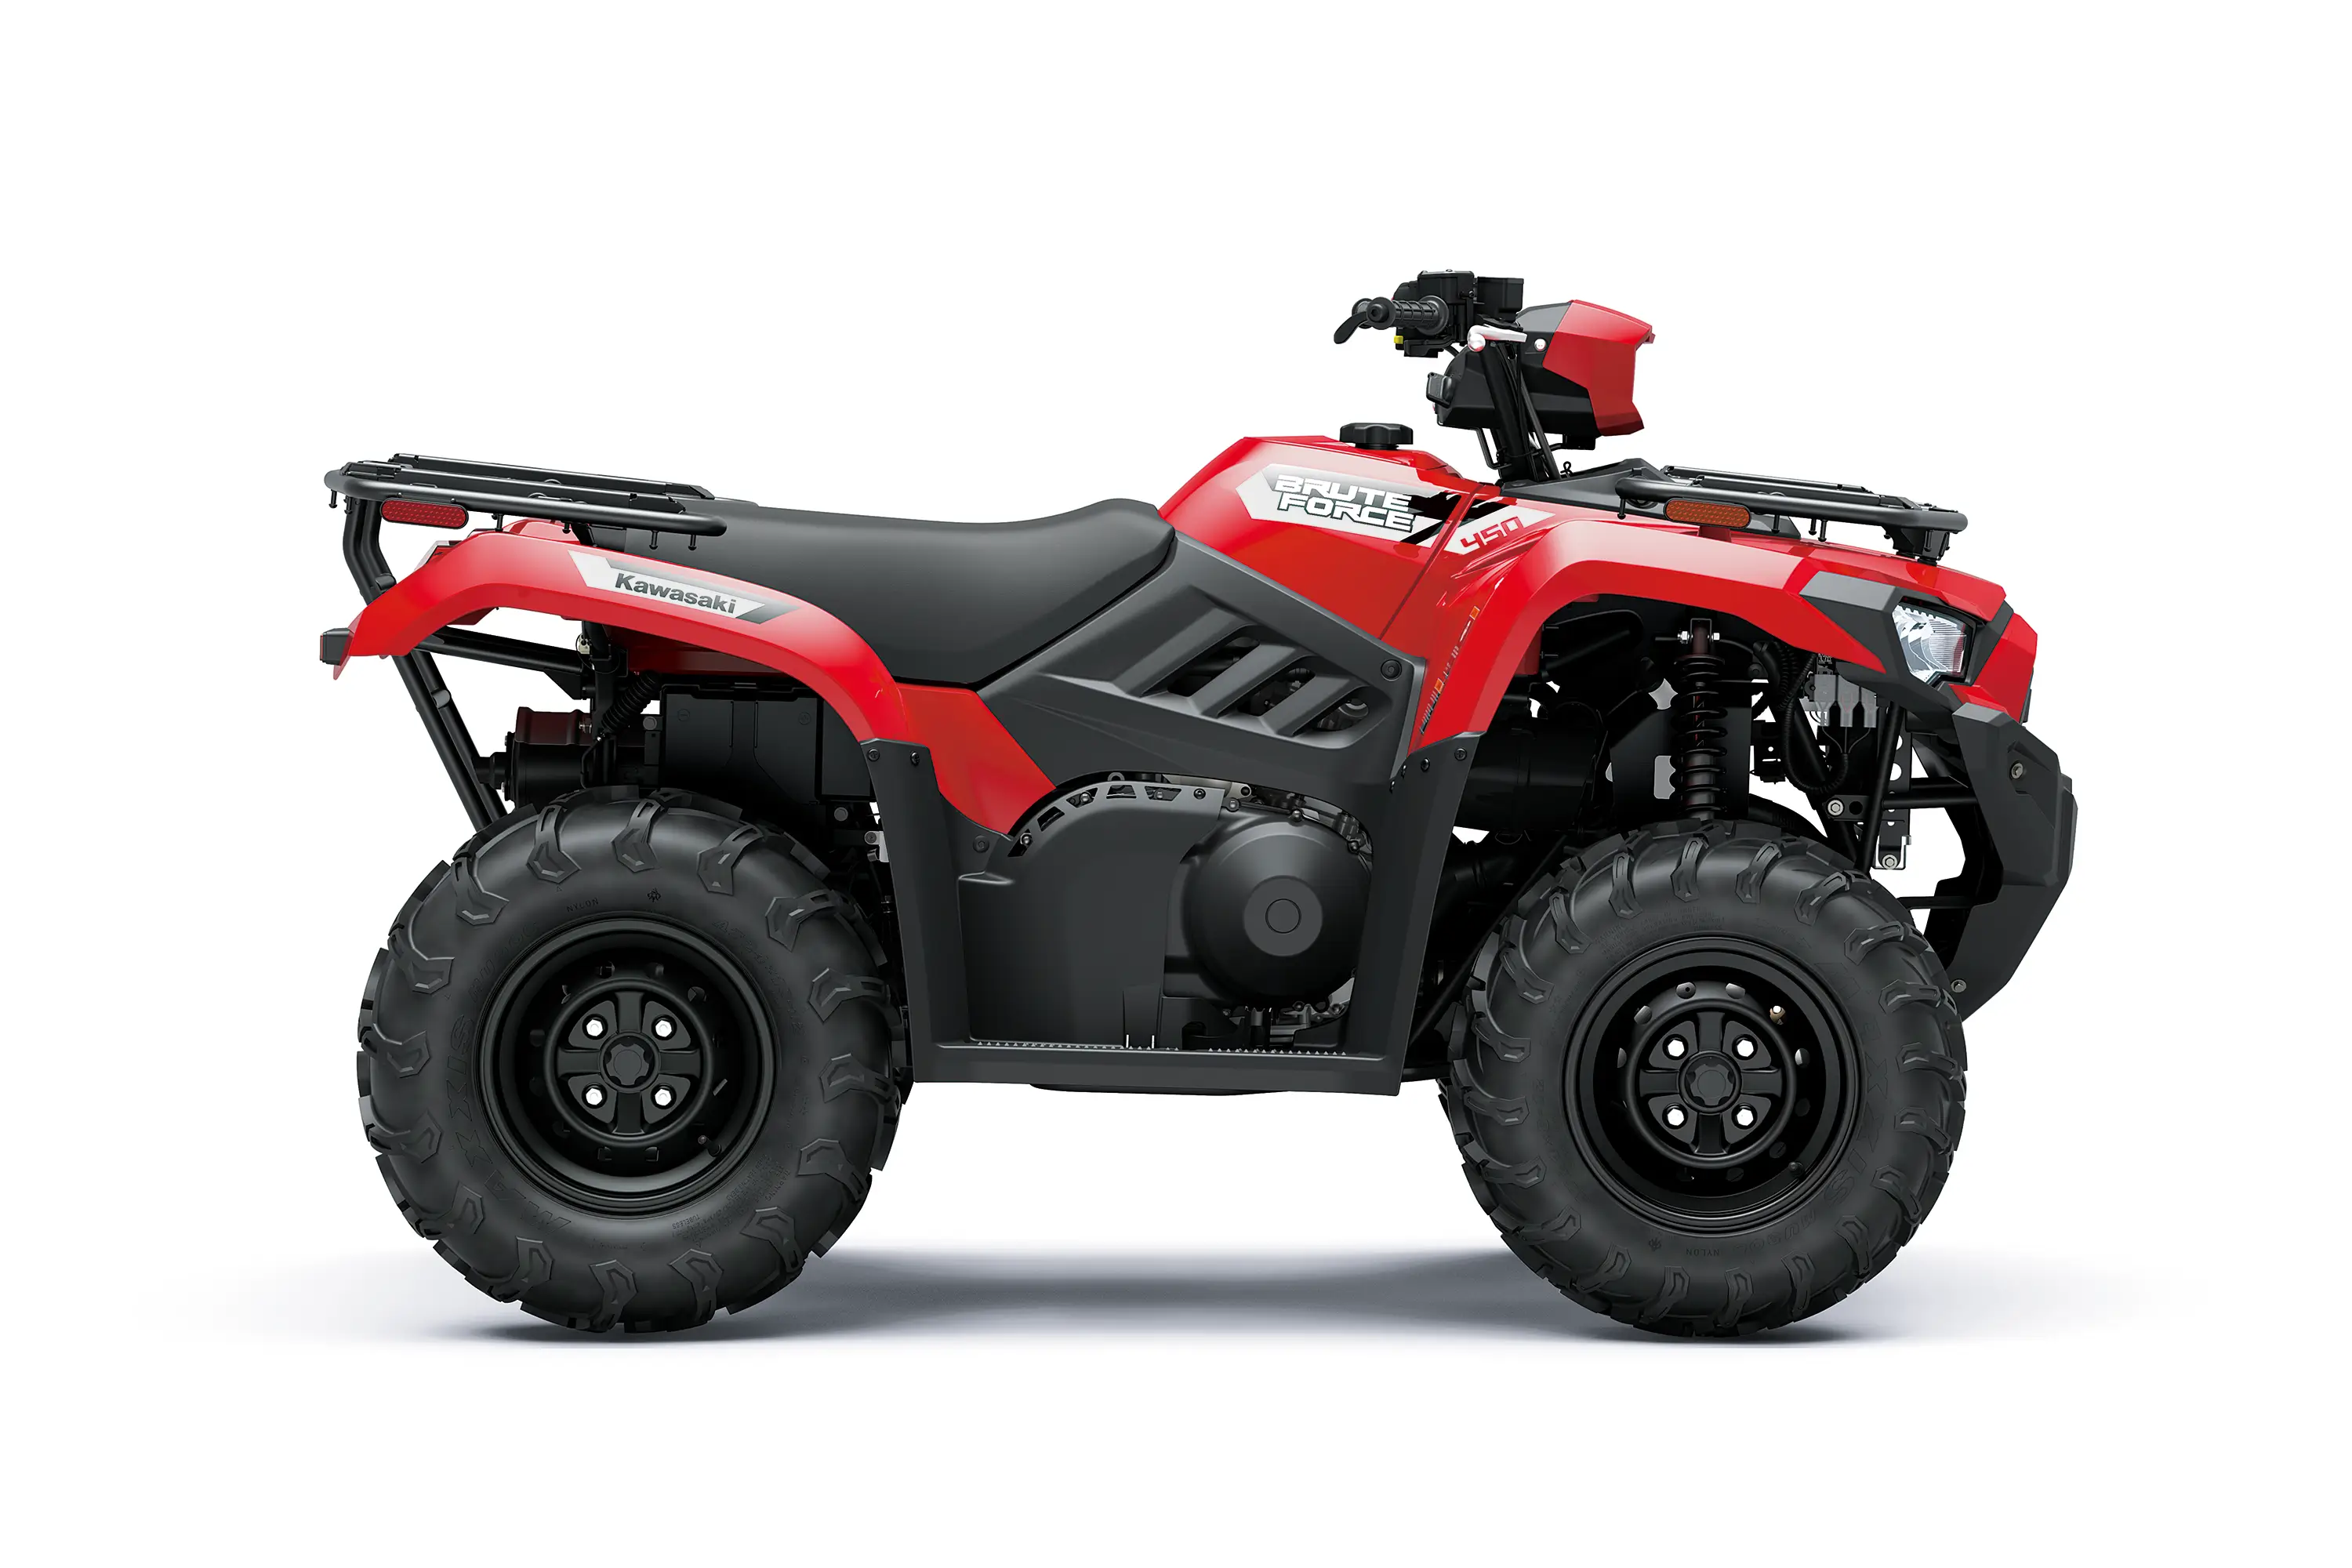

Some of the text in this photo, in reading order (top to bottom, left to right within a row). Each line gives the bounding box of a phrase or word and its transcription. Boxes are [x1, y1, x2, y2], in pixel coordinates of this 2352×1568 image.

[1273, 474, 1412, 512] BRUTE
[1277, 492, 1414, 533] FORCE
[1460, 516, 1525, 548] 450
[615, 572, 736, 614] Kawasaki
[566, 897, 600, 913] NYLON
[445, 1014, 572, 1235] MAXXIS
[1686, 1248, 1720, 1258] NYLON
